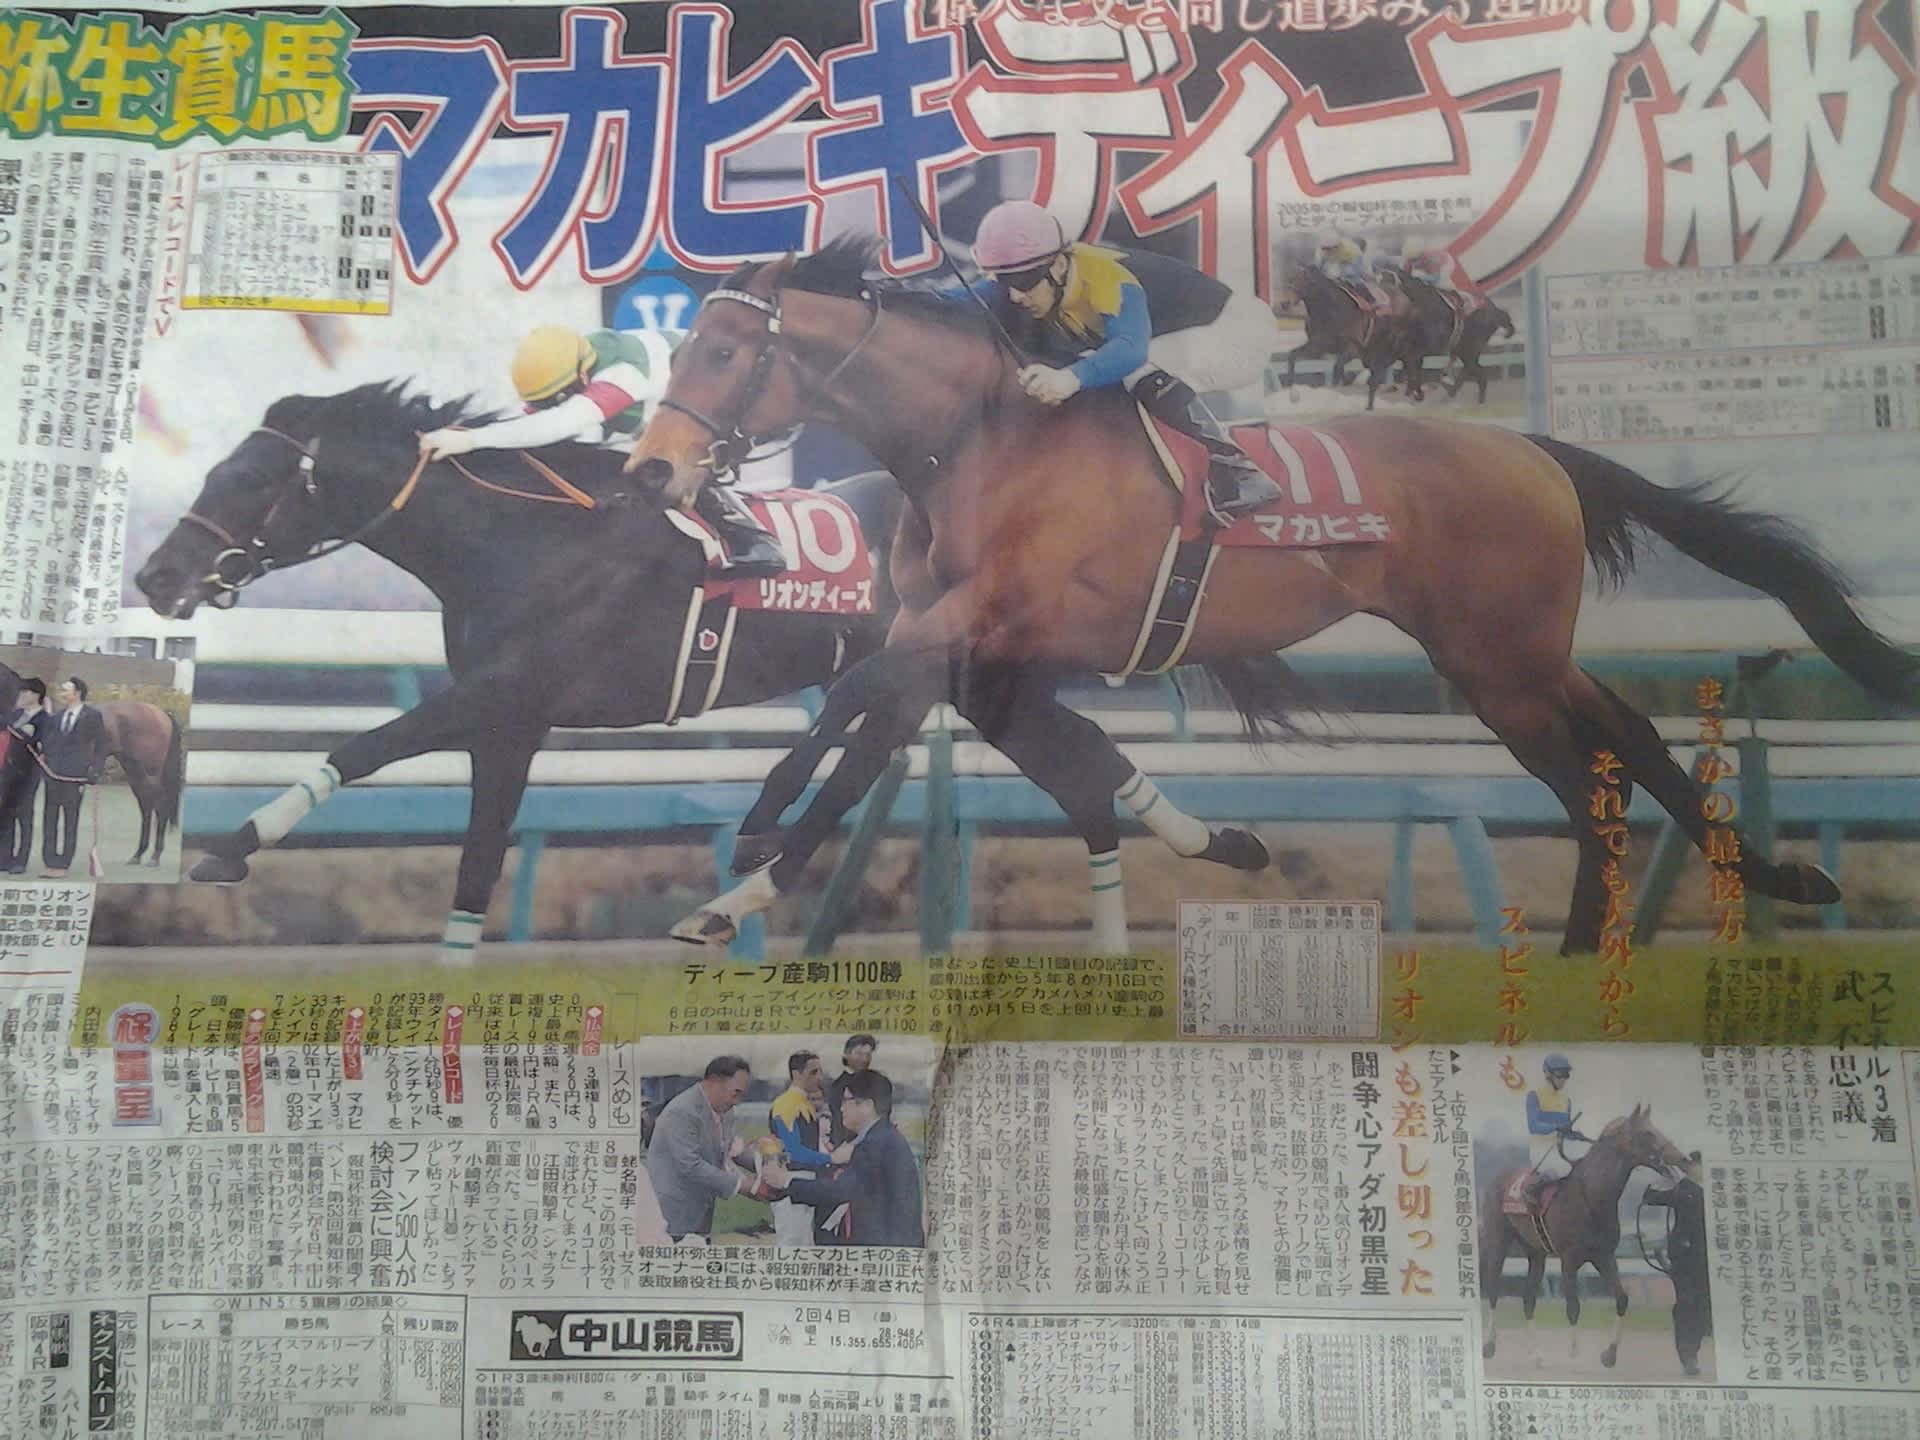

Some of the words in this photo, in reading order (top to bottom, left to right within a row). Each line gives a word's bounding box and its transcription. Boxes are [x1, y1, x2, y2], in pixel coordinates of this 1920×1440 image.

[0, 19, 347, 143] 弥生賞馬
[350, 0, 985, 288] マカヒキ
[1269, 428, 1362, 505] 11
[764, 498, 858, 574] 10
[1253, 513, 1391, 544] マカヒキ
[684, 960, 902, 985] ディープ産駒1100勝
[611, 1034, 632, 1125] レースめも
[370, 1140, 395, 1289] 検討会に興奮
[395, 1141, 421, 1289] ファン500人が
[1351, 1051, 1391, 1297] 闘争心アダ初黒星
[638, 1246, 925, 1262] 報知杯弥生賞を制したマカヒキの金子
[568, 1318, 737, 1354] 中山競馬
[795, 1308, 851, 1324] 2回4日
[117, 1310, 138, 1440] 完勝に小牧絶
